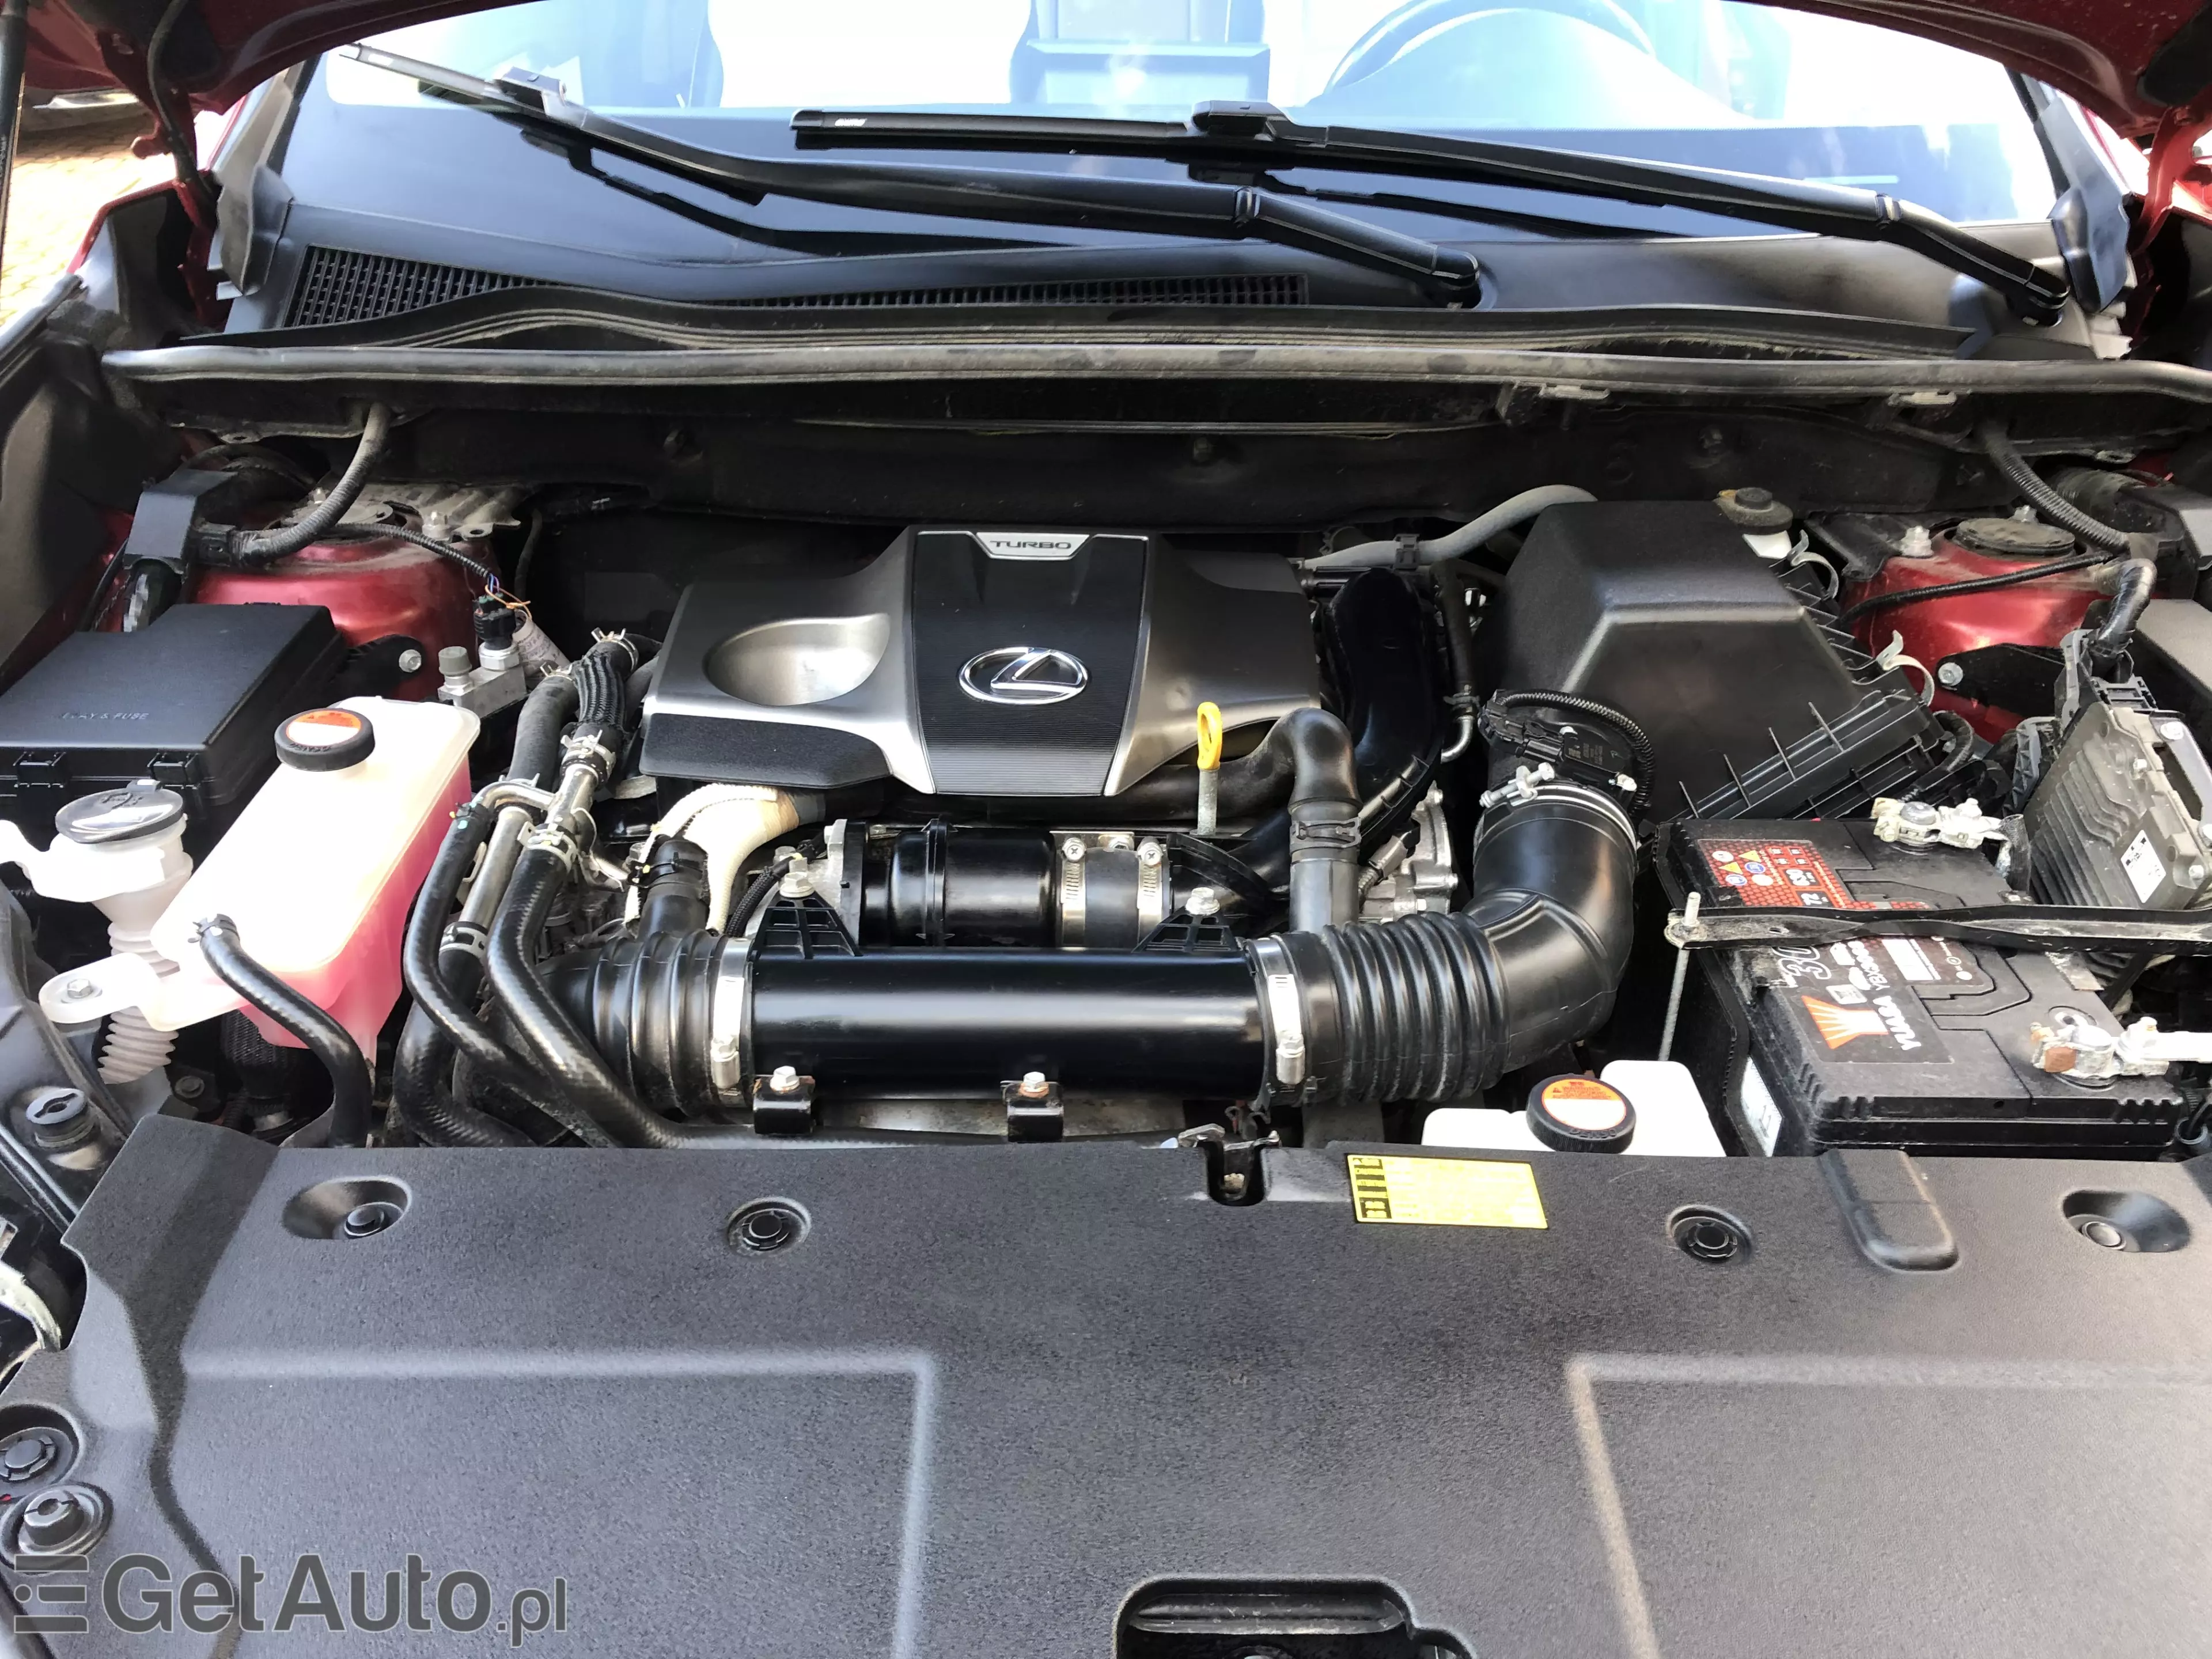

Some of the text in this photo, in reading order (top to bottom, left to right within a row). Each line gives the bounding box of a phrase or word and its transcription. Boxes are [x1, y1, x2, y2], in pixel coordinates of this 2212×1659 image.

[990, 540, 1072, 549] TURBO
[1801, 893, 1823, 906] 72
[1872, 995, 1922, 1051] YUASA
